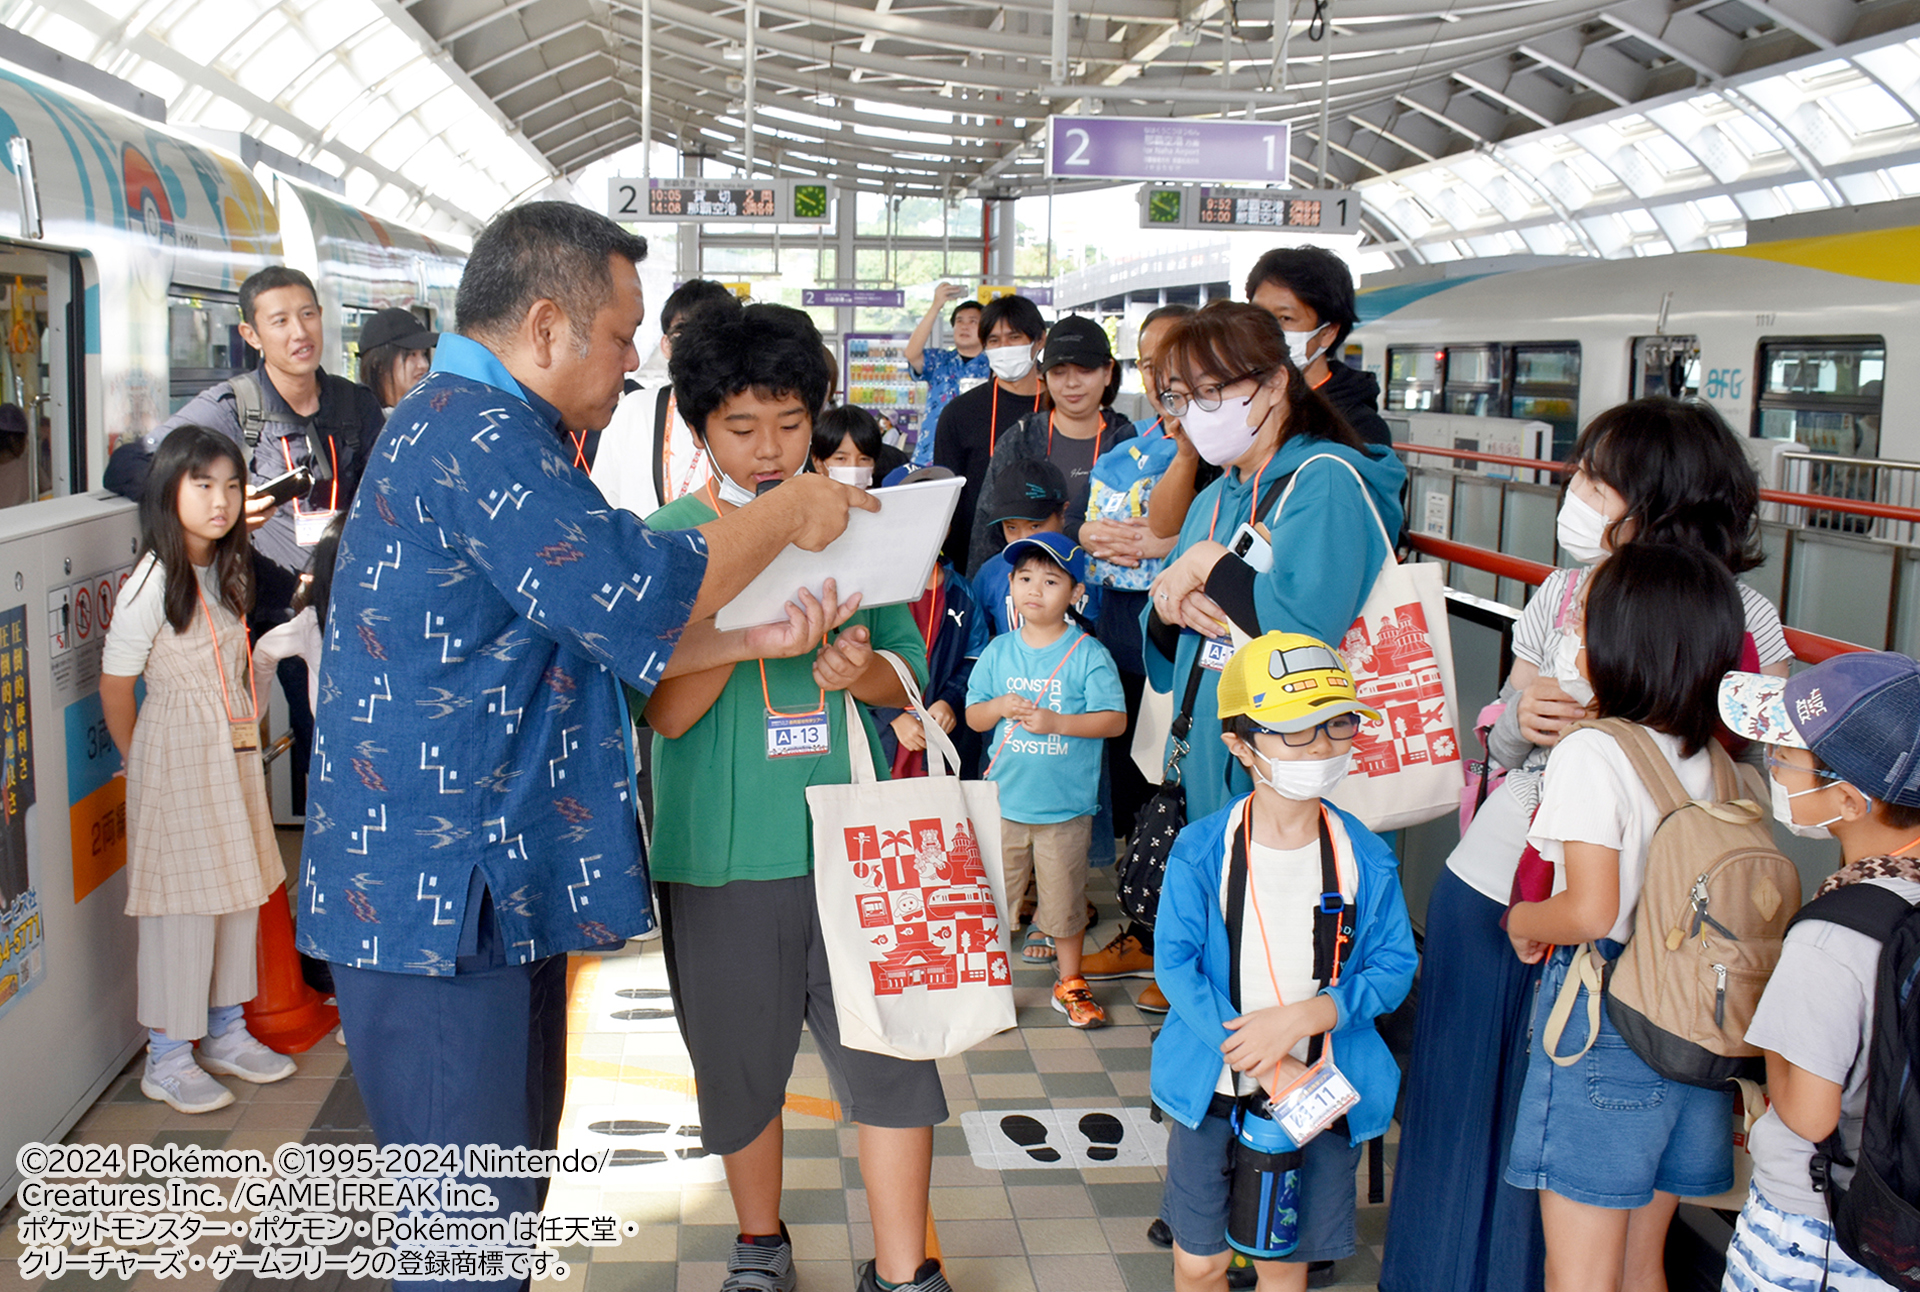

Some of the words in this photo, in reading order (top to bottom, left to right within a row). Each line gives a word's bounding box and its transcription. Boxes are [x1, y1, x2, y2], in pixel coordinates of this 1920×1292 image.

[1064, 127, 1090, 166] 2
[1263, 134, 1276, 171] 1
[619, 185, 638, 213] 2
[651, 189, 682, 201] 10:05
[651, 202, 682, 214] 14:08
[1206, 198, 1232, 210] 9:52
[1336, 198, 1347, 226] 1
[1201, 210, 1232, 222] 10:00
[806, 291, 815, 304] 2
[896, 292, 902, 305] 1
[777, 726, 819, 745] A-13
[1011, 739, 1069, 755] SYSTEM
[0, 886, 38, 924] ービス社
